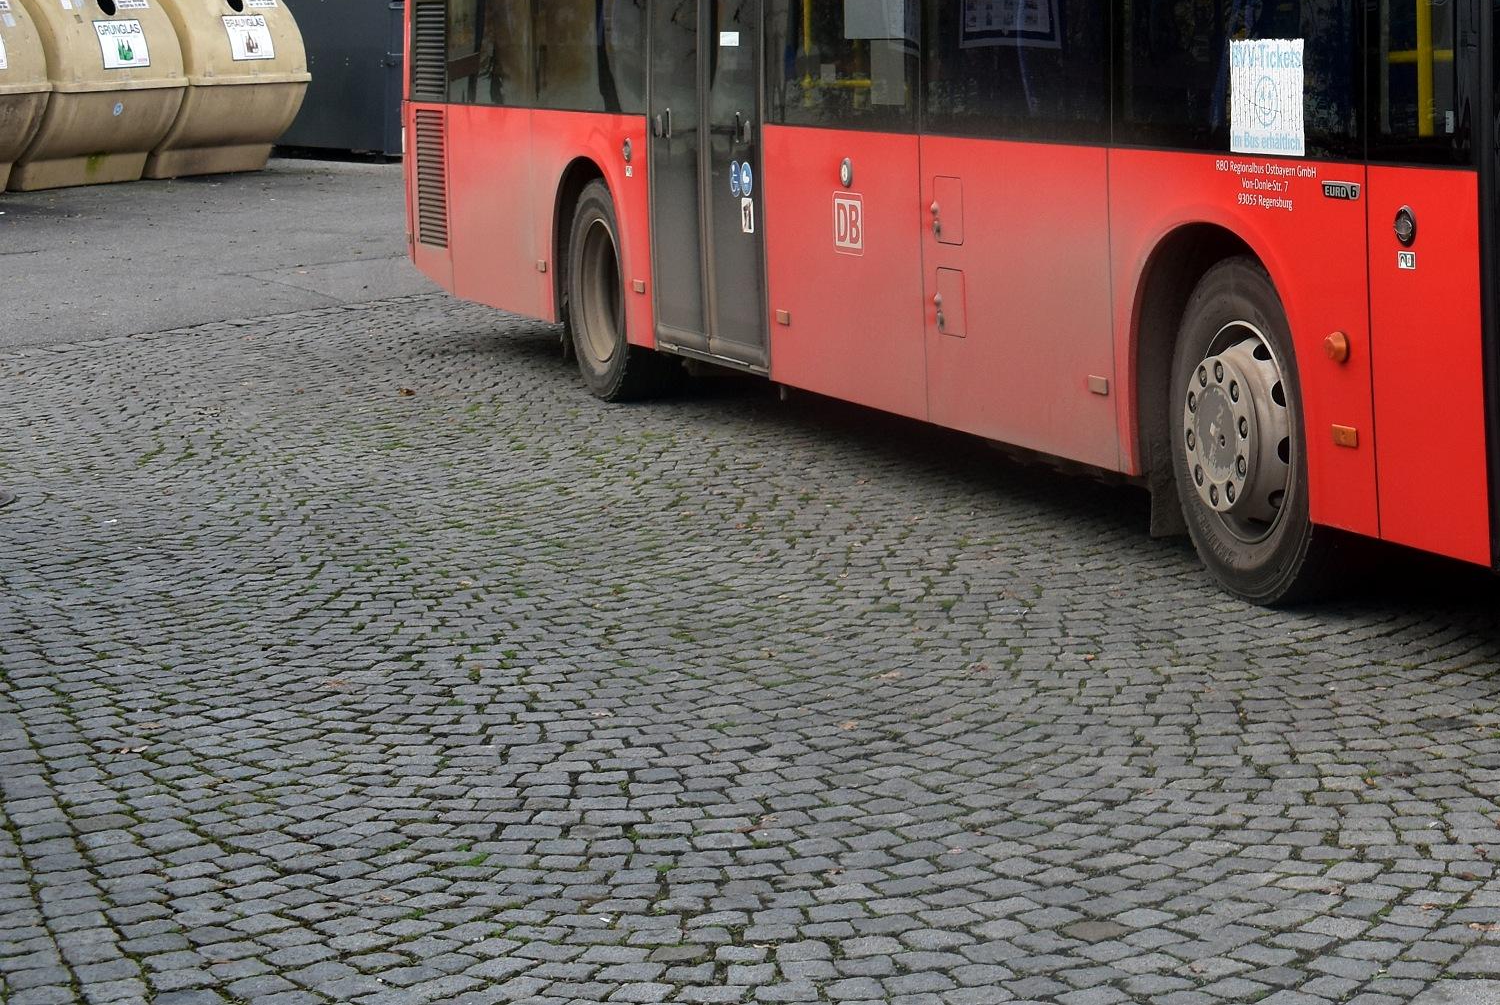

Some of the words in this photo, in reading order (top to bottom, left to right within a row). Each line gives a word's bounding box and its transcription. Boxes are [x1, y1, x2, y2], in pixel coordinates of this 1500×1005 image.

[97, 22, 141, 36] GRÜNGLAS
[225, 17, 265, 28] BRAUNGLAS
[1244, 131, 1260, 148] Bus
[1215, 160, 1229, 172] RBO
[1230, 161, 1264, 174] Regionalbus
[1265, 163, 1296, 178] Ostbayern
[1297, 165, 1317, 178] GmbH
[1284, 181, 1289, 193] 7
[1324, 185, 1347, 198] EURO
[1351, 186, 1358, 197] 6
[1238, 193, 1257, 206] 93055
[1258, 195, 1293, 211] Regensburg
[837, 202, 860, 245] DB
